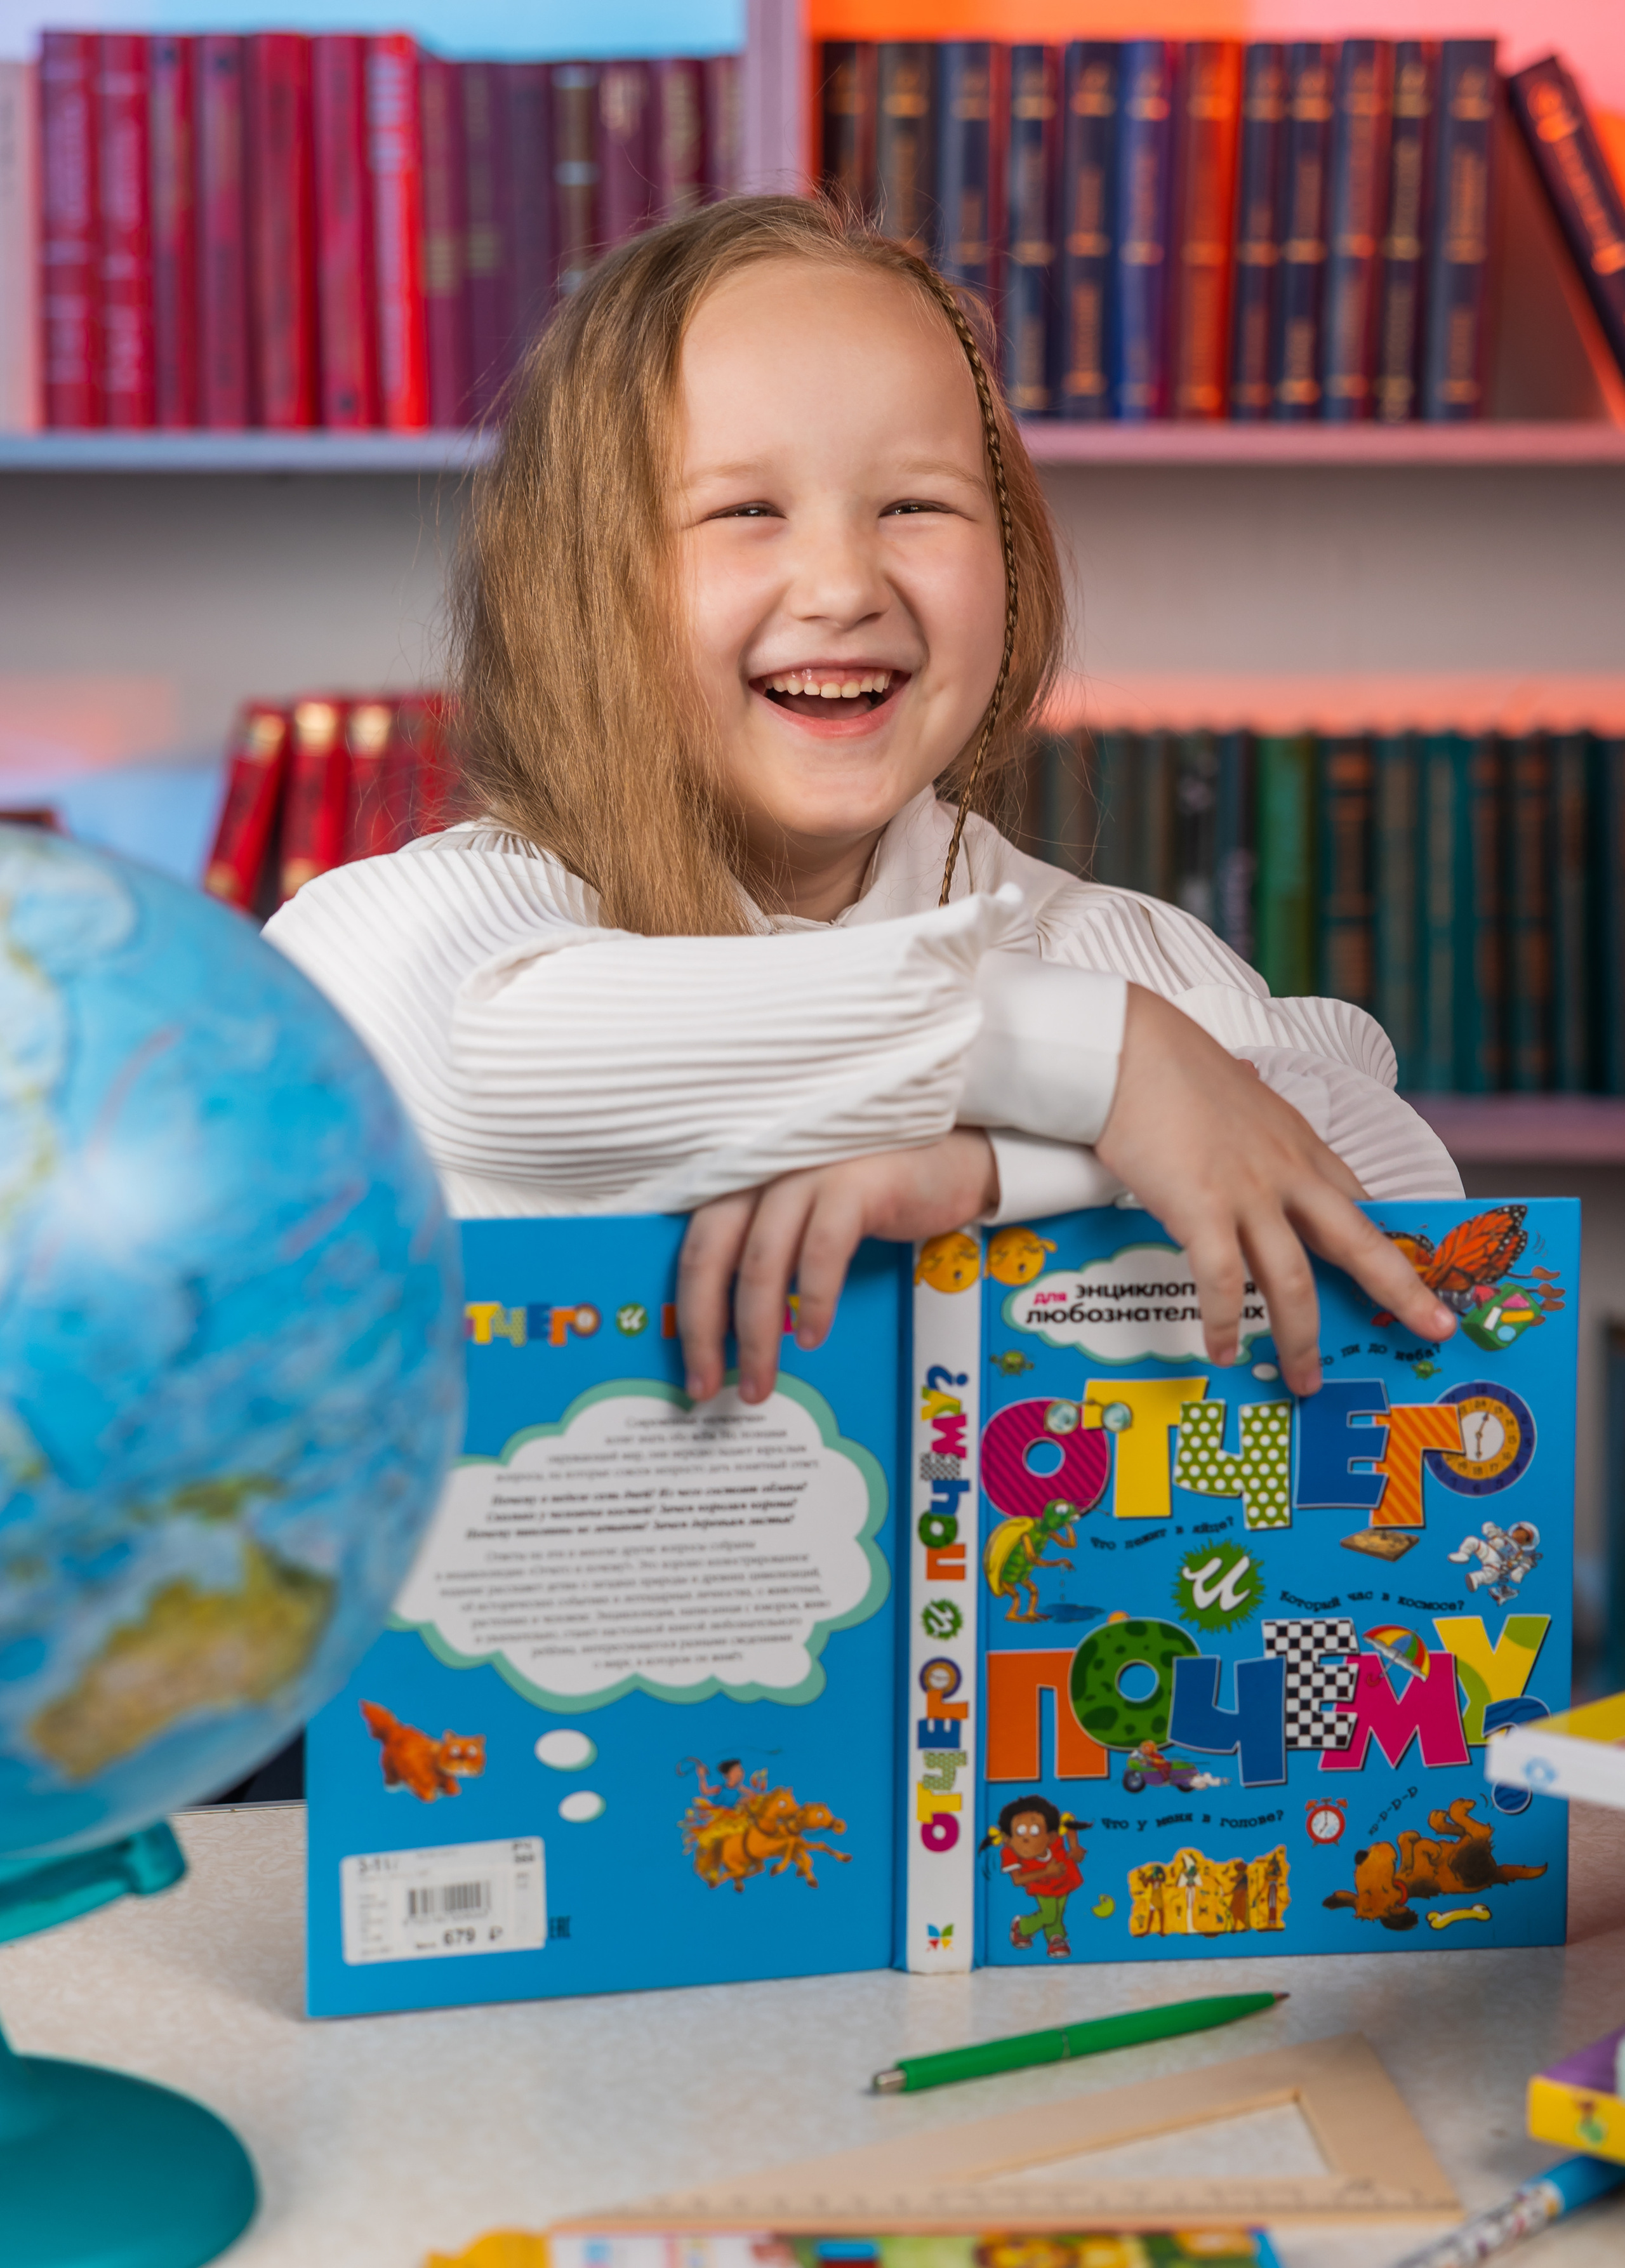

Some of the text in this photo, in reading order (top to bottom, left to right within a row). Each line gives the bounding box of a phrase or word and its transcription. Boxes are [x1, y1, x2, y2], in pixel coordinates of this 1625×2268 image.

[1033, 1291, 1067, 1305] для
[1075, 1282, 1256, 1301] энциклопя
[465, 1301, 602, 1346] ТЧЕГО
[1026, 1302, 1264, 1324] любознателх
[1368, 1343, 1387, 1354] до
[981, 1376, 1537, 1529] ОТЧЕГО
[1091, 1537, 1116, 1549] Что
[1176, 1526, 1184, 1535] в
[1182, 1555, 1251, 1612] и
[1280, 1590, 1464, 1612] Который час в космосе?
[1101, 1810, 1283, 1832] Что у меня в голове?
[444, 1926, 476, 1946] 679
